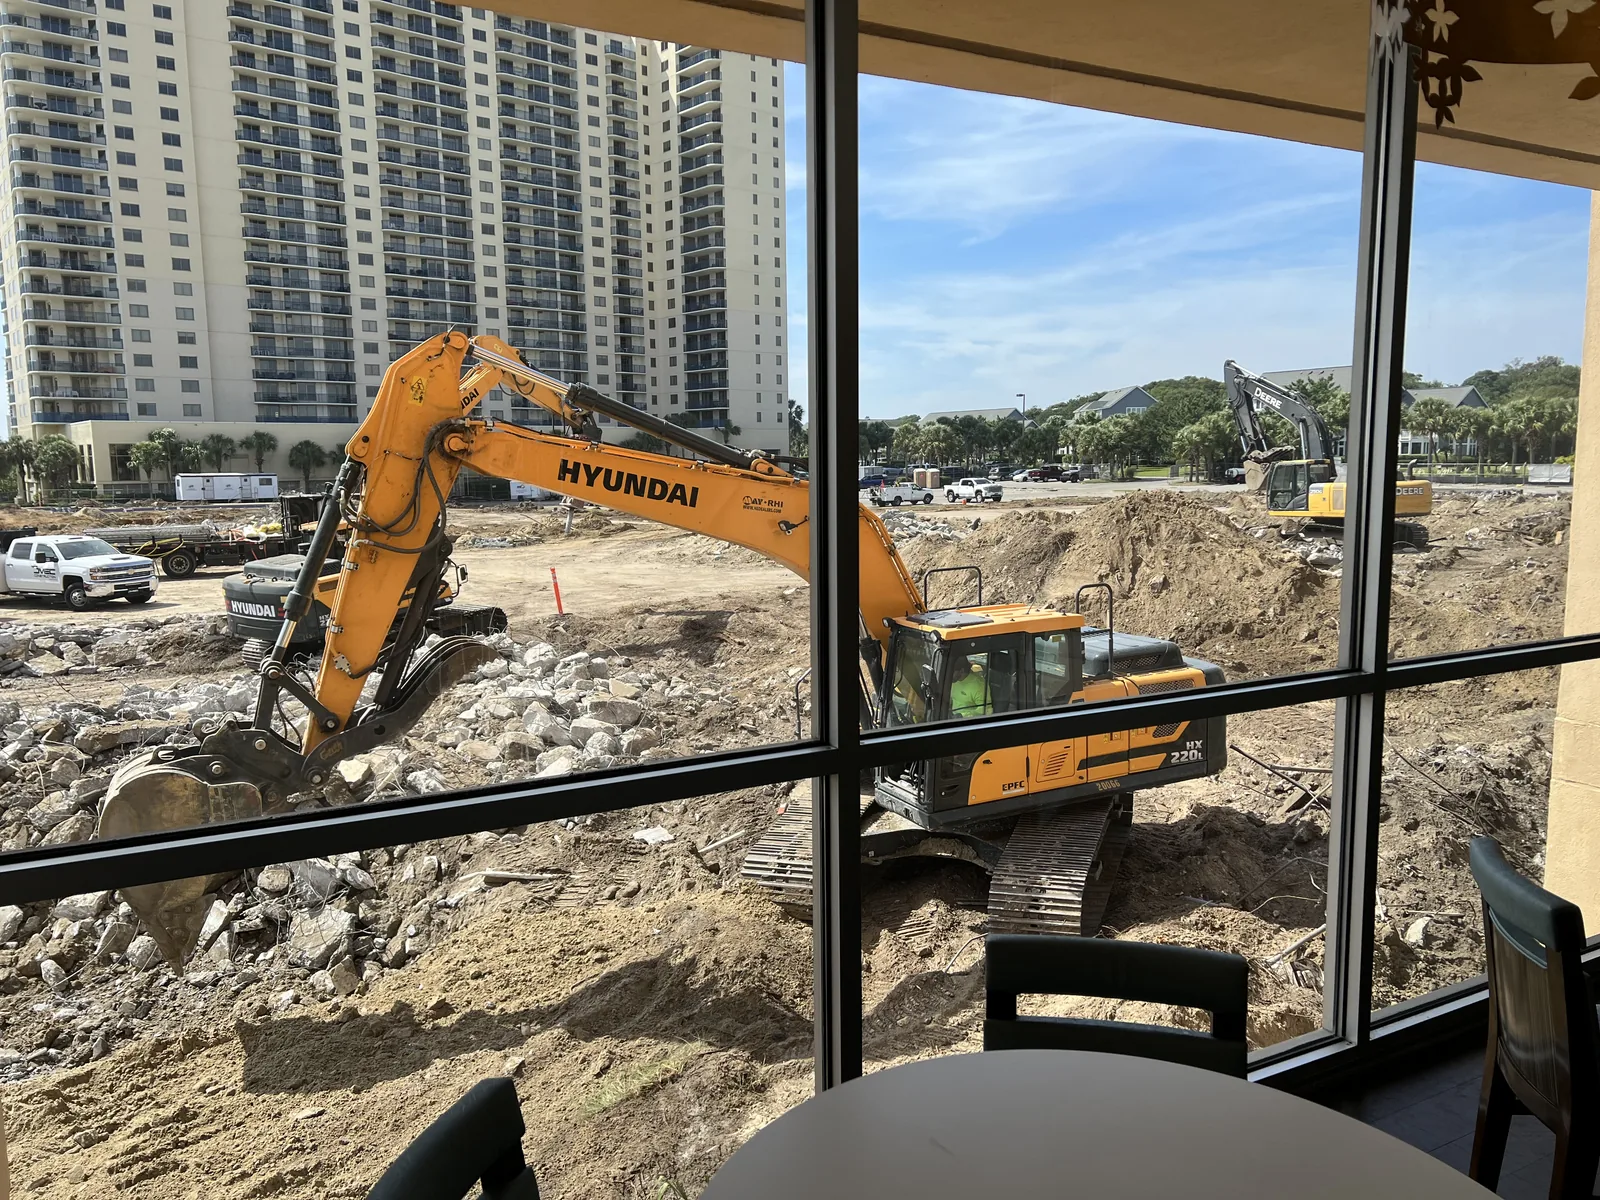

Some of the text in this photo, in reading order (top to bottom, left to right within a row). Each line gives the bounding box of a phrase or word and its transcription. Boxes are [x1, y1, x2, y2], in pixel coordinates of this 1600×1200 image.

[1254, 386, 1283, 410] DEERE
[557, 458, 700, 508] HYUNDAI
[1395, 486, 1424, 496] DEERE
[230, 600, 277, 618] HYUNDAI
[1186, 739, 1203, 750] HX
[1170, 749, 1204, 764] 220L
[1002, 780, 1025, 791] EPFC
